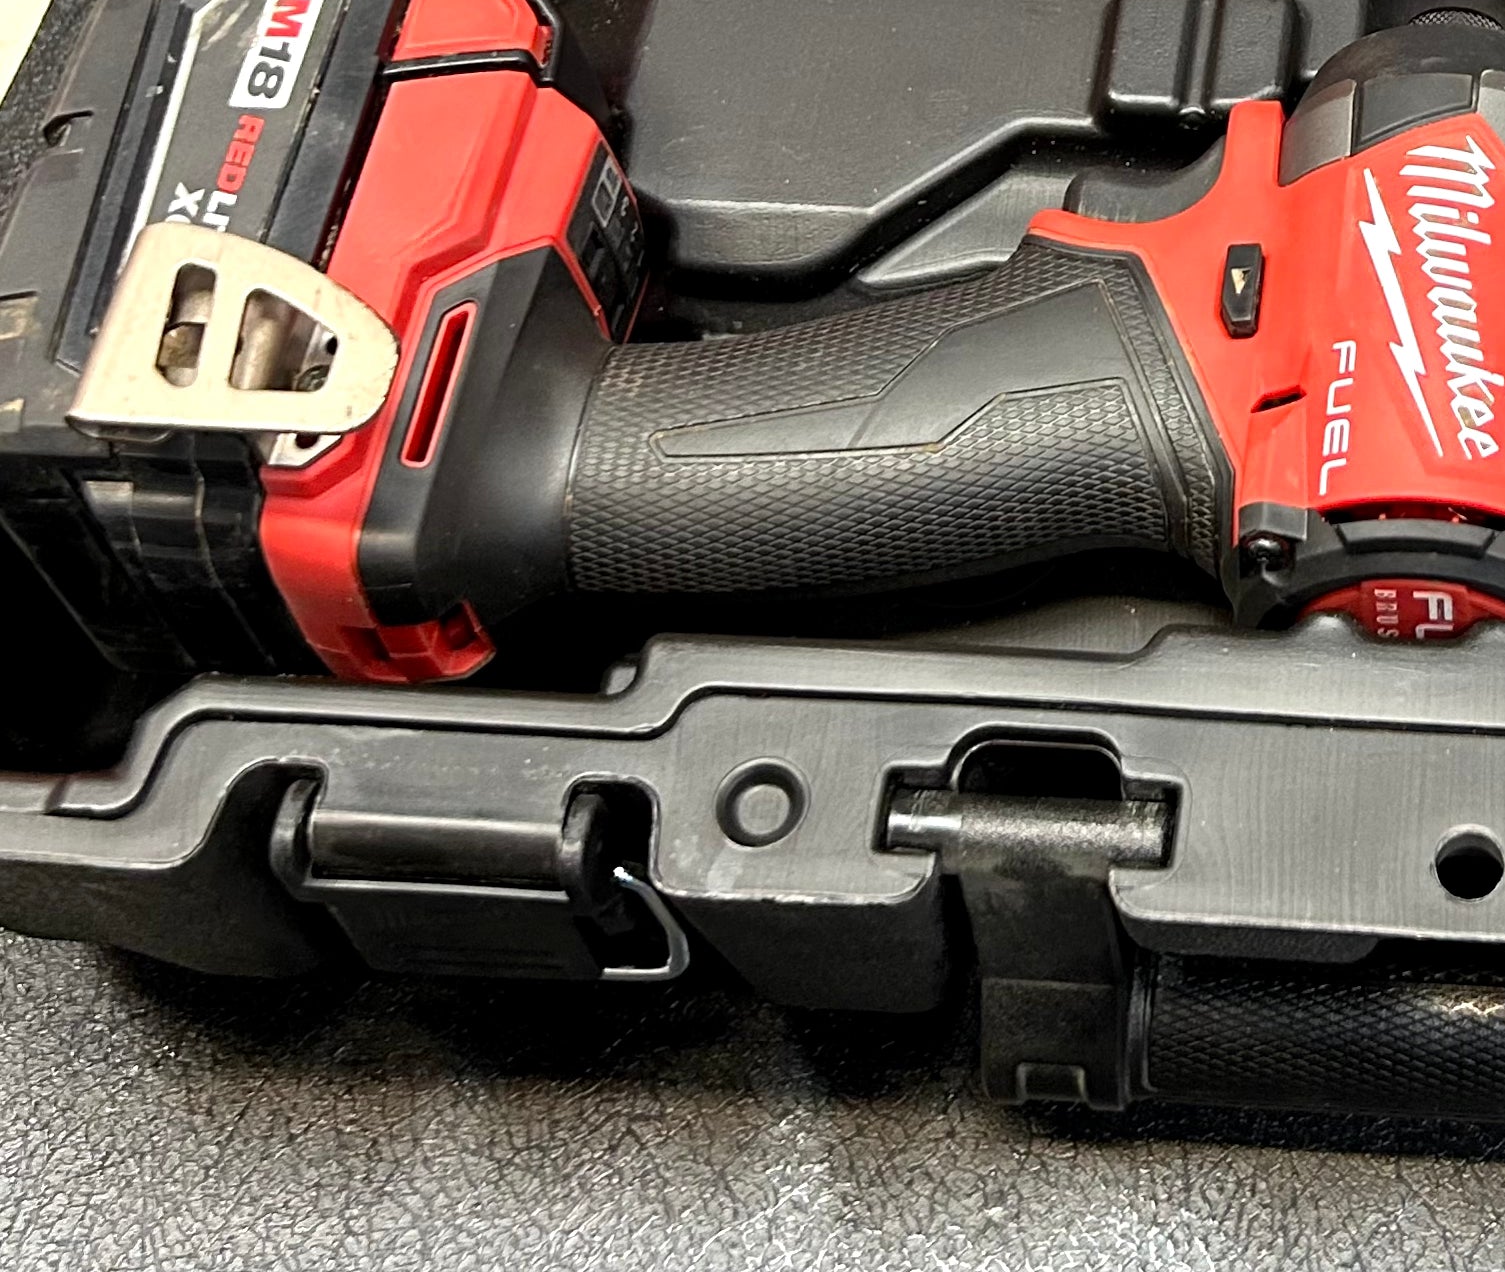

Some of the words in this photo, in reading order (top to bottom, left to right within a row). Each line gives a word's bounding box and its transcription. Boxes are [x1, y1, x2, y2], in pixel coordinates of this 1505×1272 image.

[204, 114, 265, 233] REDLI
[1399, 134, 1504, 462] Milwaukee
[1318, 339, 1357, 496] FUEL
